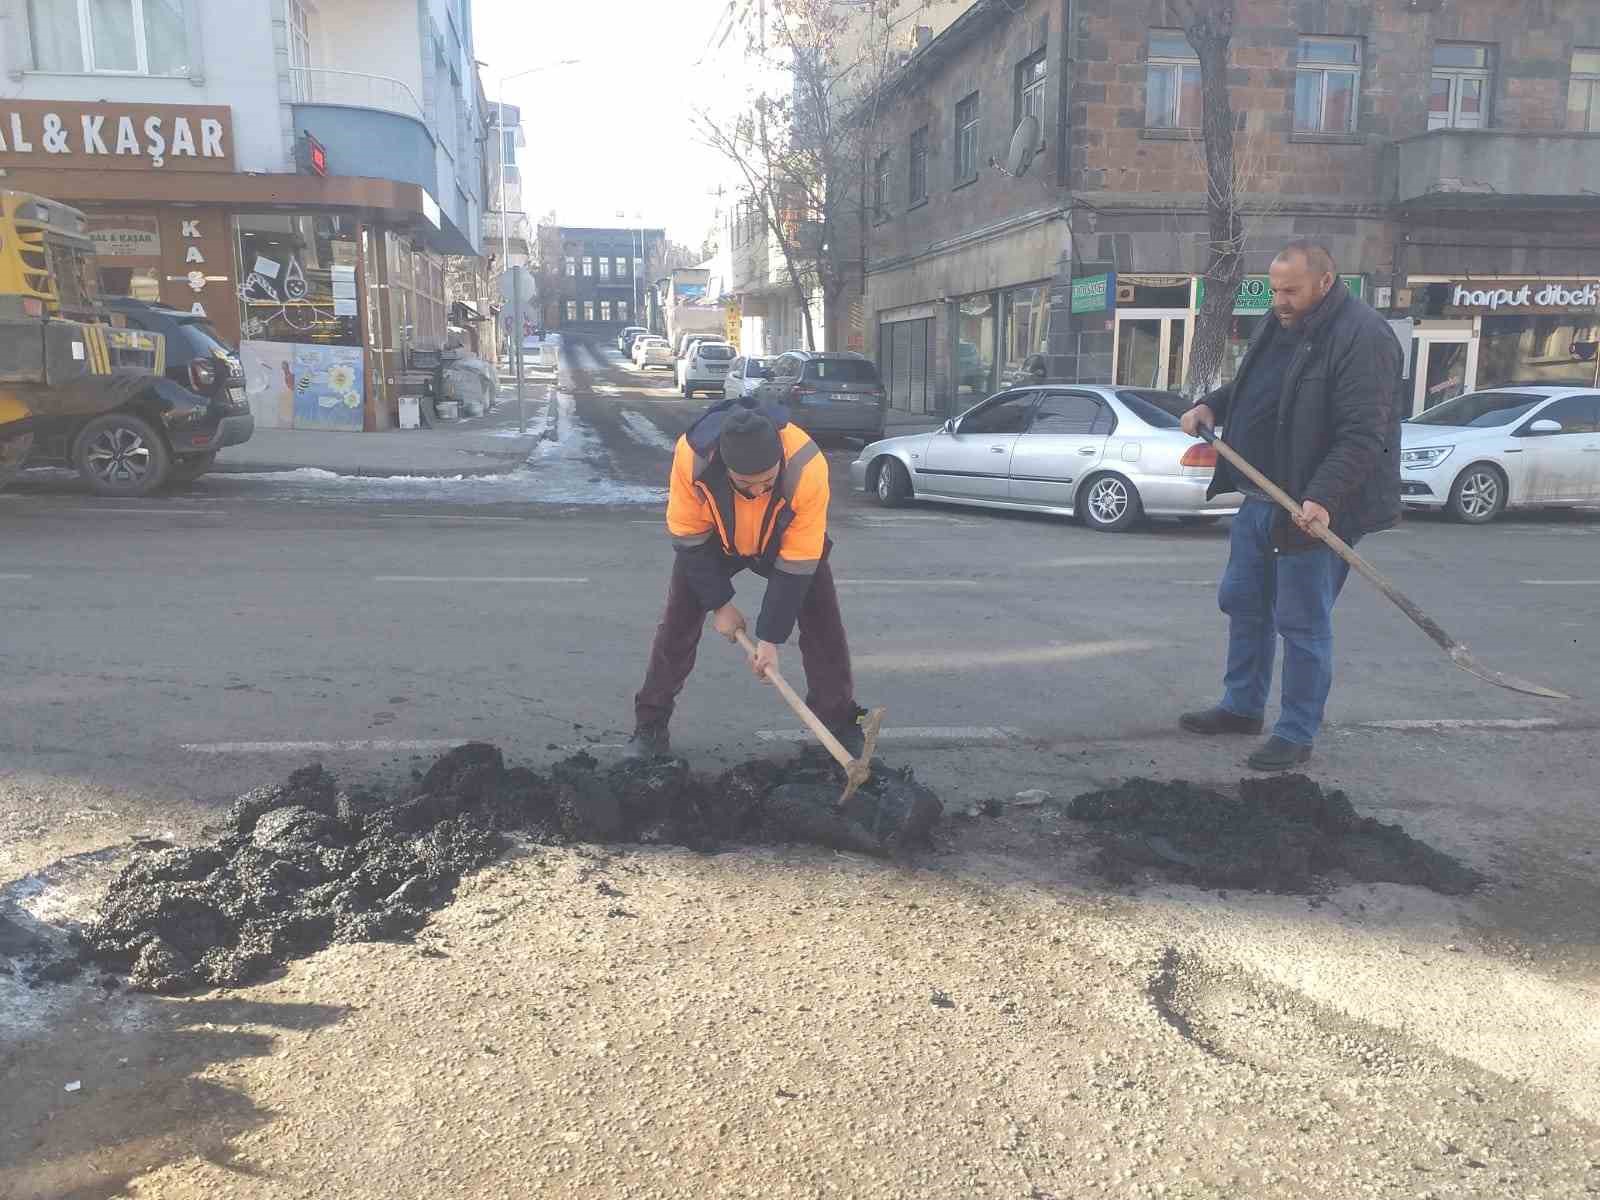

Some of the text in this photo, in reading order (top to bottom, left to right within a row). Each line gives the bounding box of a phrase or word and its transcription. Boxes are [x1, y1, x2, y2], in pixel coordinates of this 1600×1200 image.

[42, 113, 71, 153] &
[81, 114, 225, 168] KAŞAR
[1452, 284, 1531, 311] harput
